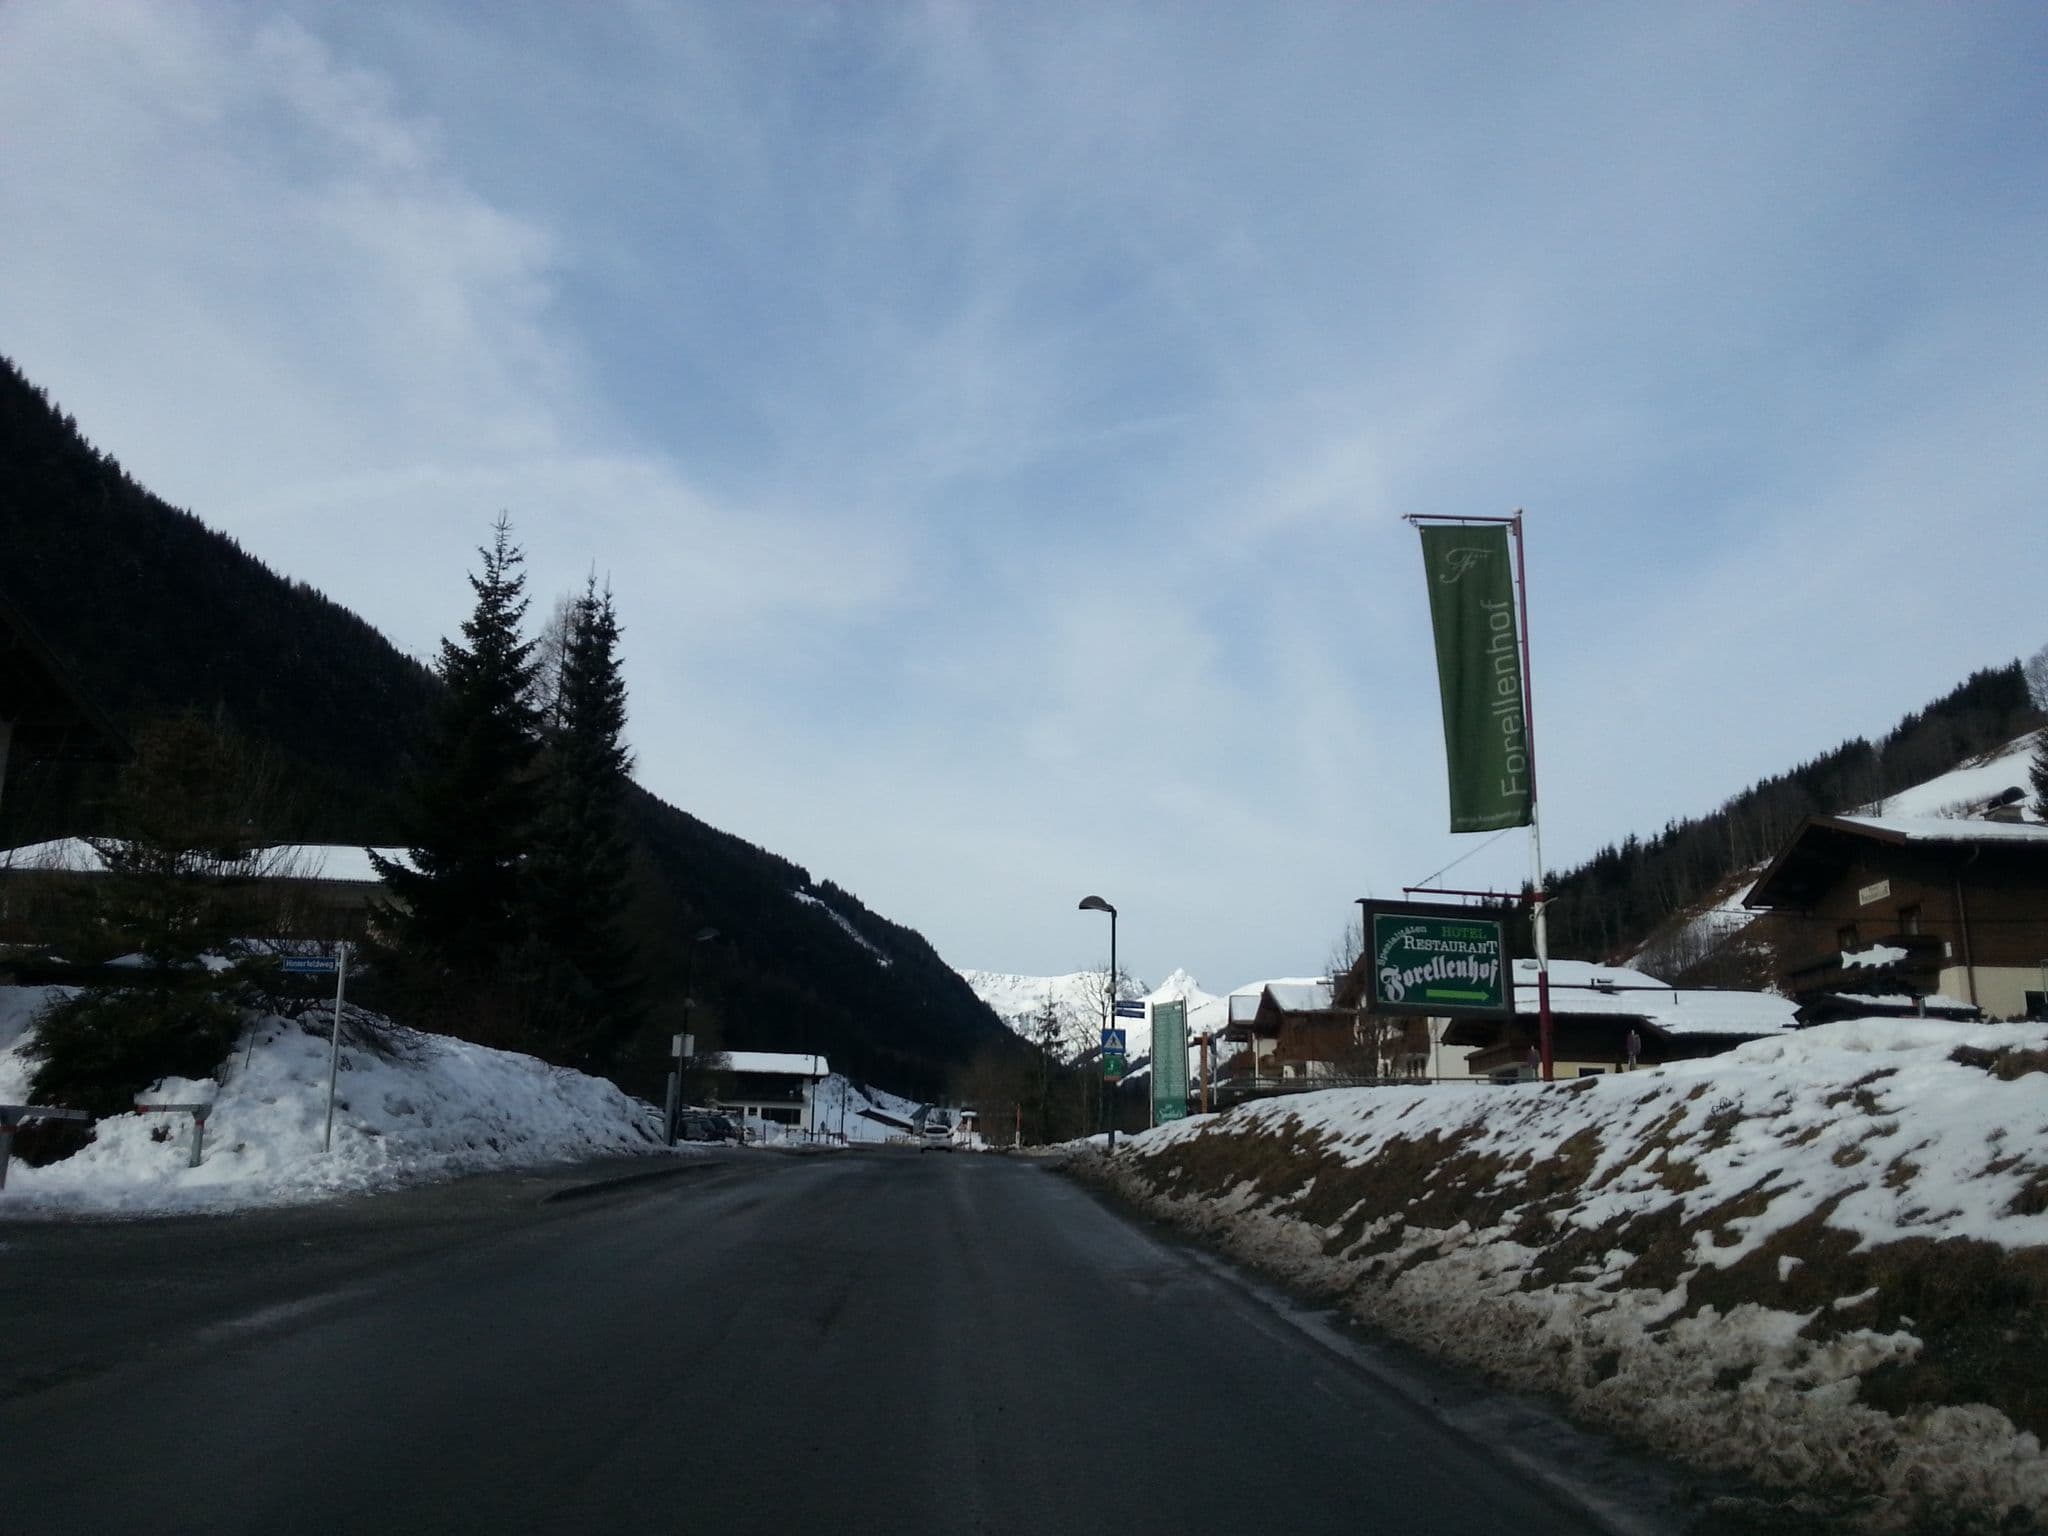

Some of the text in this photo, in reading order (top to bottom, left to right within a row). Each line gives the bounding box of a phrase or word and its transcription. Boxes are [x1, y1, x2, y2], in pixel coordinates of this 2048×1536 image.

[1480, 600, 1528, 797] Forellenhof
[1403, 935, 1498, 954] RESTAURANT
[1442, 926, 1487, 939] HOTEL
[1380, 955, 1498, 1001] Forellenhof
